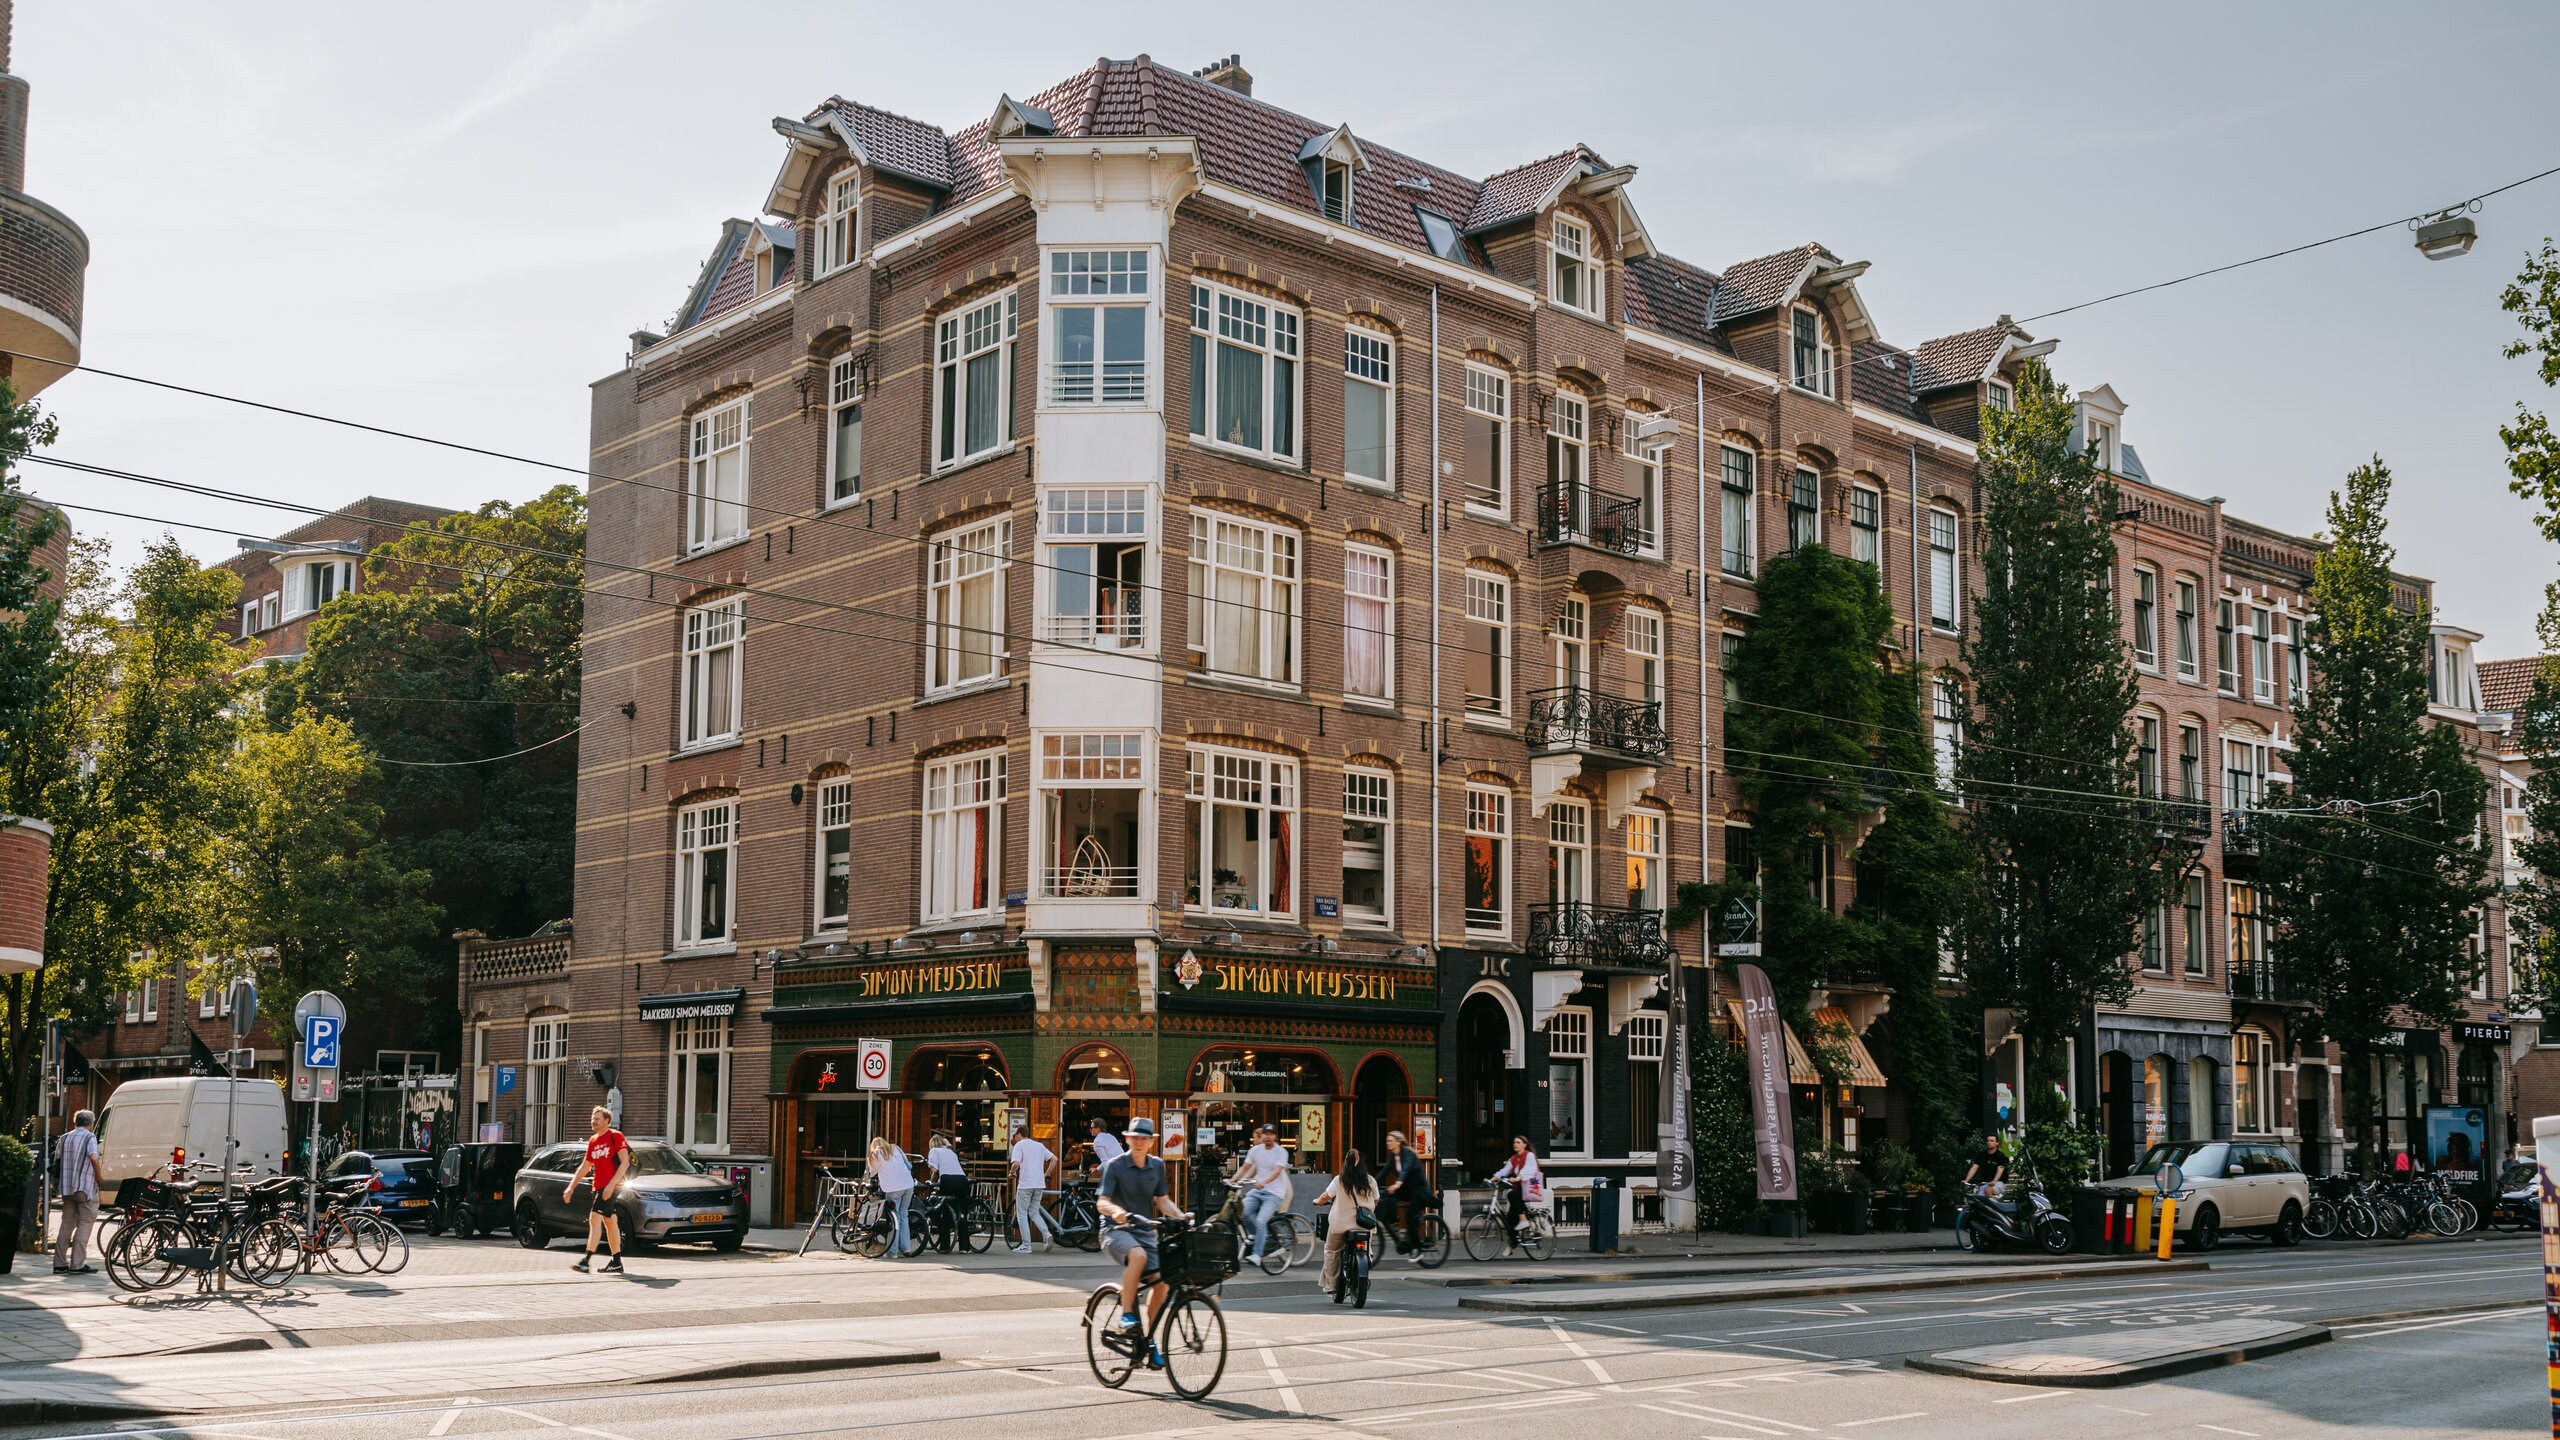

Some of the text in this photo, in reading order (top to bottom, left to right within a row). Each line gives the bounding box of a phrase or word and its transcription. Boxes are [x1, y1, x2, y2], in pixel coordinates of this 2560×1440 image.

[1724, 911, 1747, 921] Brand
[1479, 956, 1511, 977] JLC
[859, 970, 913, 997] SIMON
[1215, 965, 1289, 994] SIMON
[642, 1003, 735, 1020] BAKKERIJ SIMON MEIJSSEN
[313, 1020, 332, 1046] P
[2465, 1026, 2510, 1040] PIERÔT
[189, 1067, 208, 1076] great
[868, 1059, 883, 1070] 30
[66, 1075, 85, 1083] great
[503, 1074, 511, 1086] P
